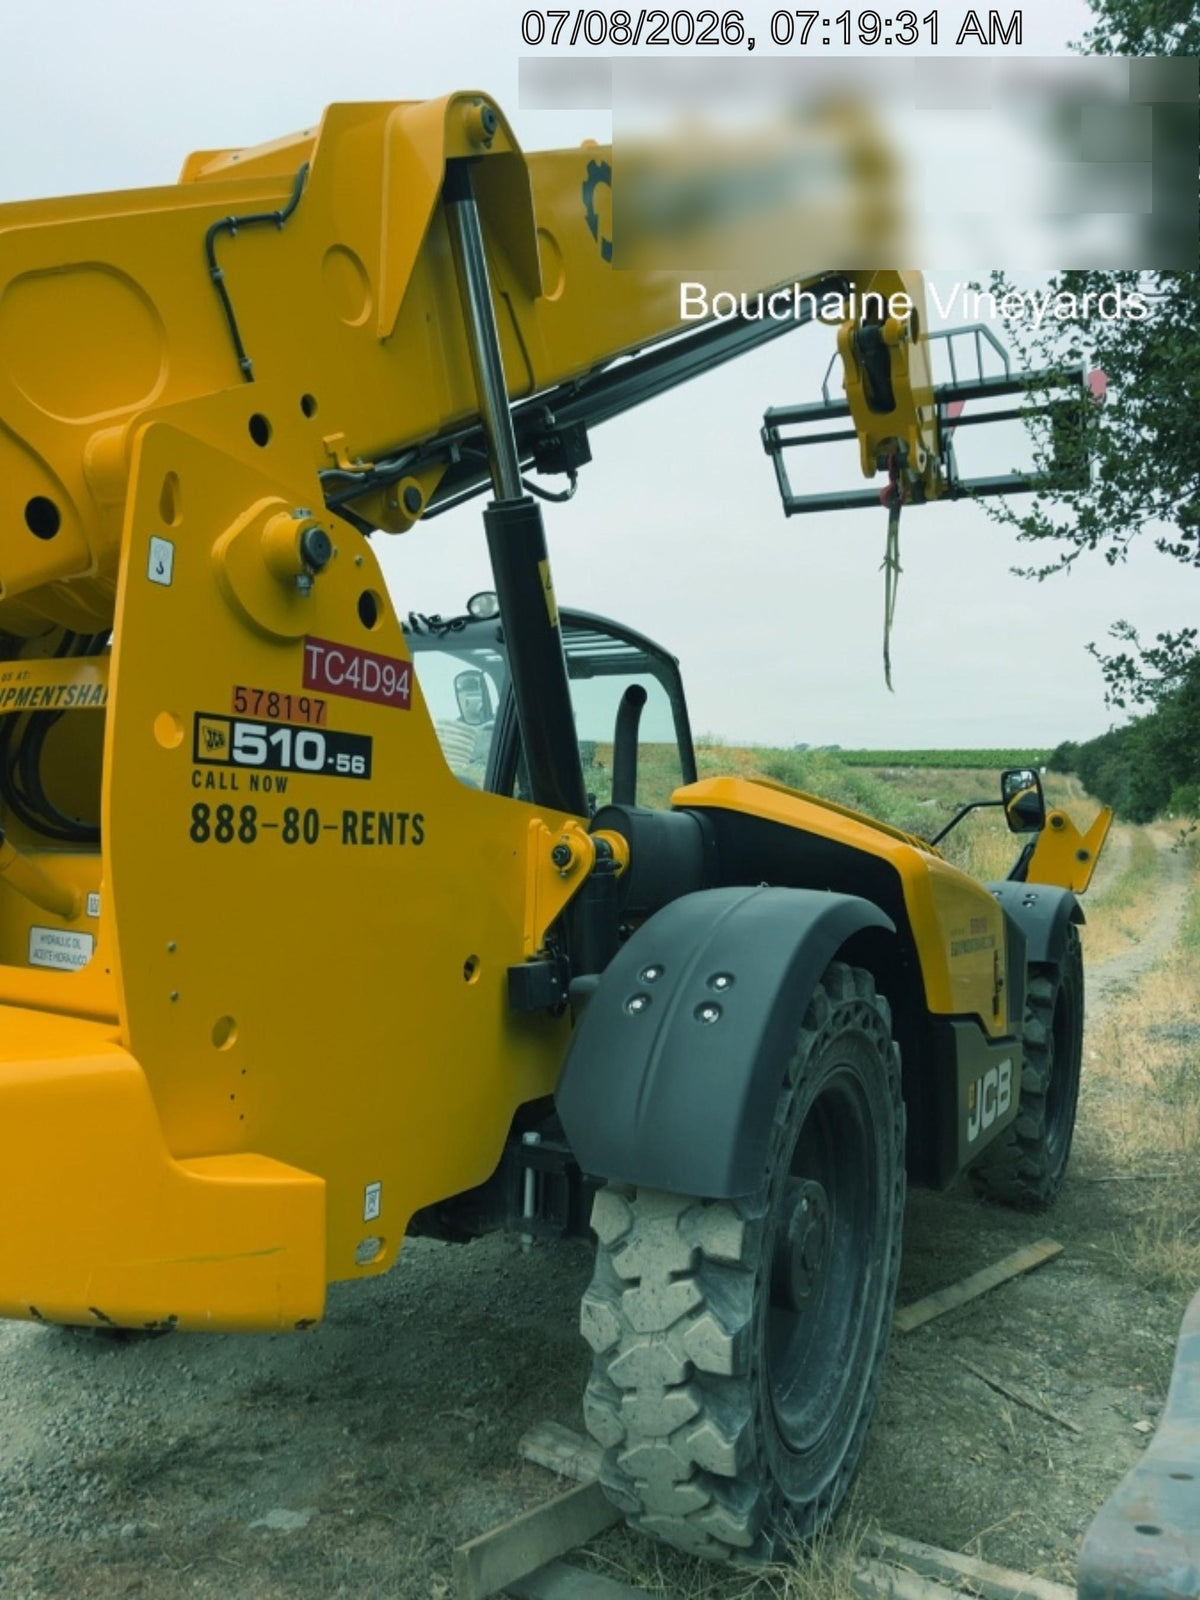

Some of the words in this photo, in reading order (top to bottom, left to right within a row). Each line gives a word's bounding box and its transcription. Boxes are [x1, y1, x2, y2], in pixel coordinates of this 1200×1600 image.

[305, 644, 410, 700] TC4D94
[233, 685, 326, 724] 578197
[191, 769, 239, 791] CALL
[250, 774, 288, 794] NOW
[189, 802, 425, 846] 888-80-RENTS
[967, 1057, 1012, 1143] JCB
